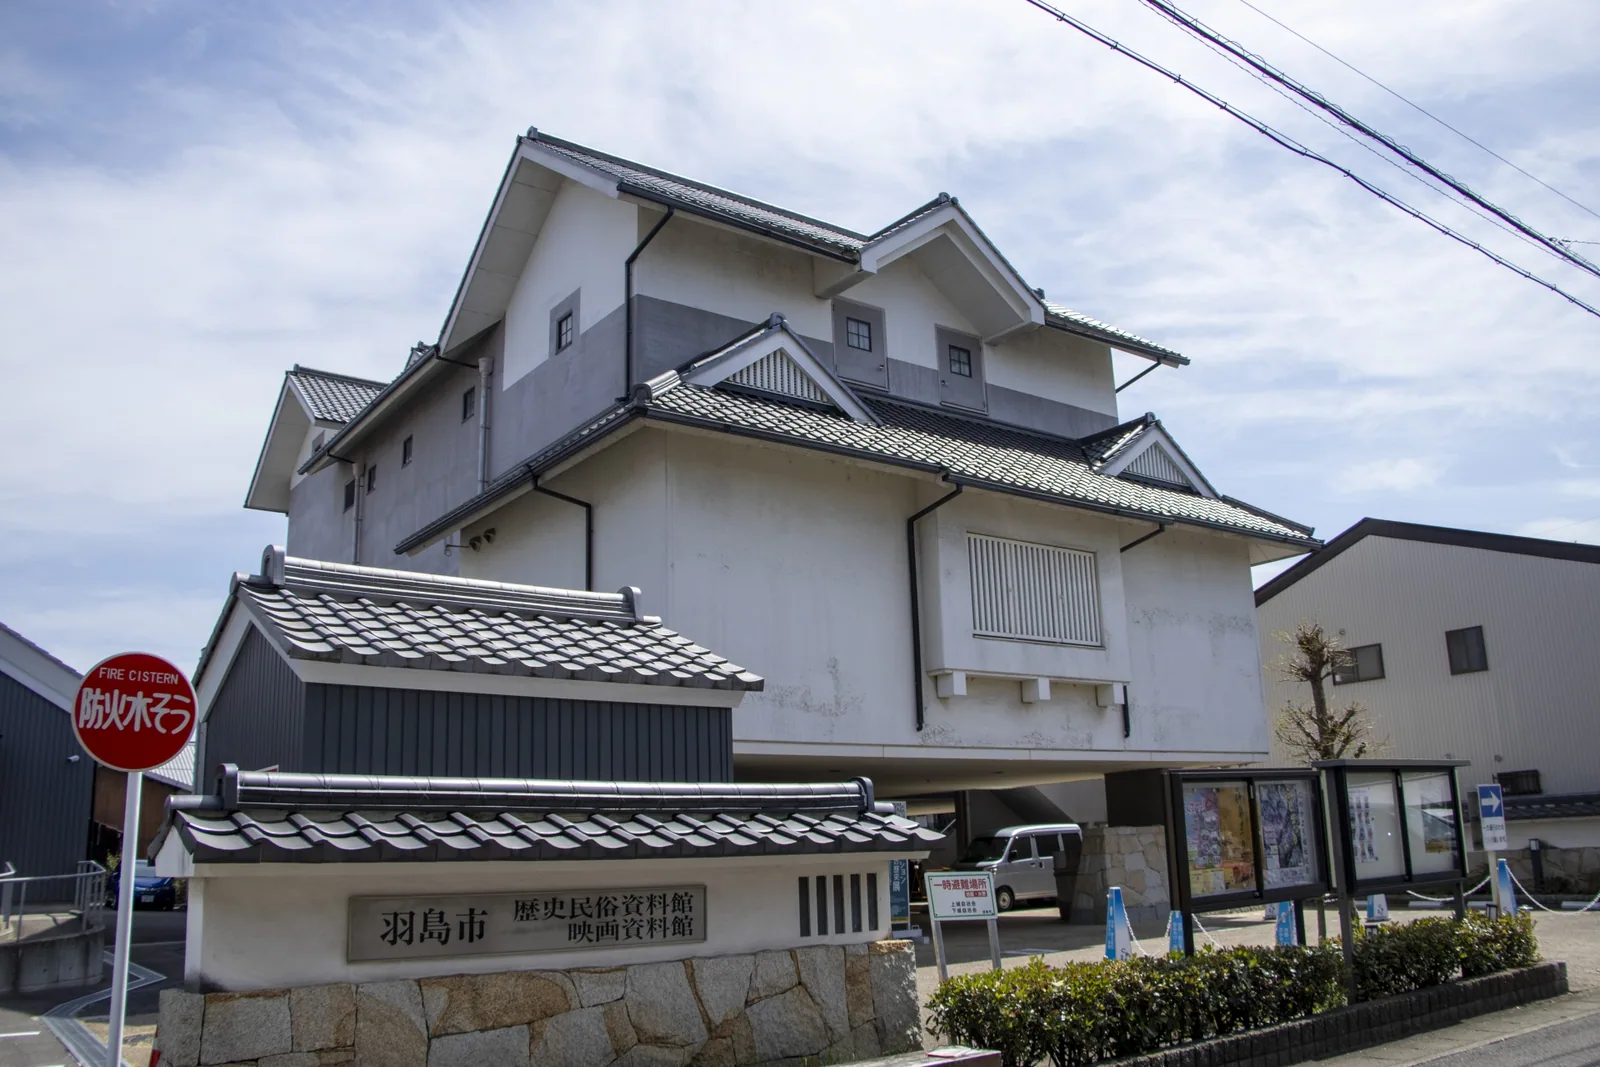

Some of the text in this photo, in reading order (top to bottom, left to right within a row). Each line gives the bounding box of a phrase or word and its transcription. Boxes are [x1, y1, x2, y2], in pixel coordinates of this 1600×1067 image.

[99, 667, 179, 685] FIRE CISTERN
[78, 687, 191, 735] 防火水そう
[933, 878, 987, 890] 一時避難場所
[513, 892, 694, 921] 歴史民俗資料館
[380, 908, 488, 946] 羽島市
[567, 915, 694, 944] 映画資料館
